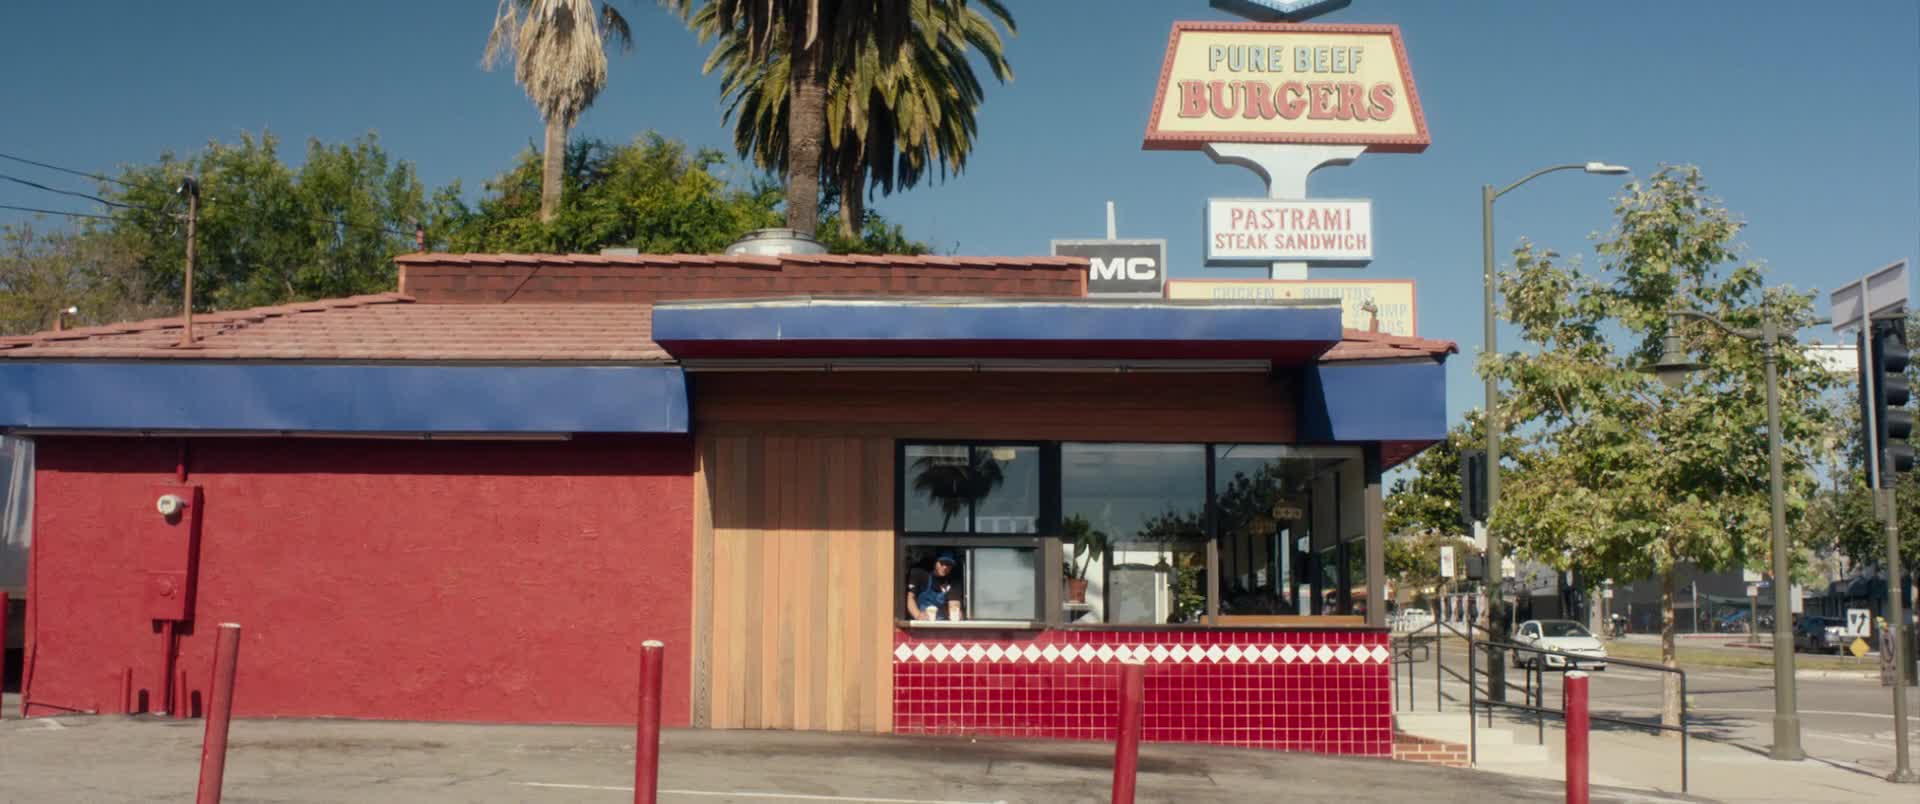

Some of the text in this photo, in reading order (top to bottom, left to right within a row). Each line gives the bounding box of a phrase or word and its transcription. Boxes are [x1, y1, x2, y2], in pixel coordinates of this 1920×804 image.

[1209, 45, 1364, 73] PURE BEEF
[1177, 79, 1396, 121] BURGERS
[1231, 208, 1351, 230] PASTRAMI
[1215, 233, 1367, 250] STEAK SANDWICH
